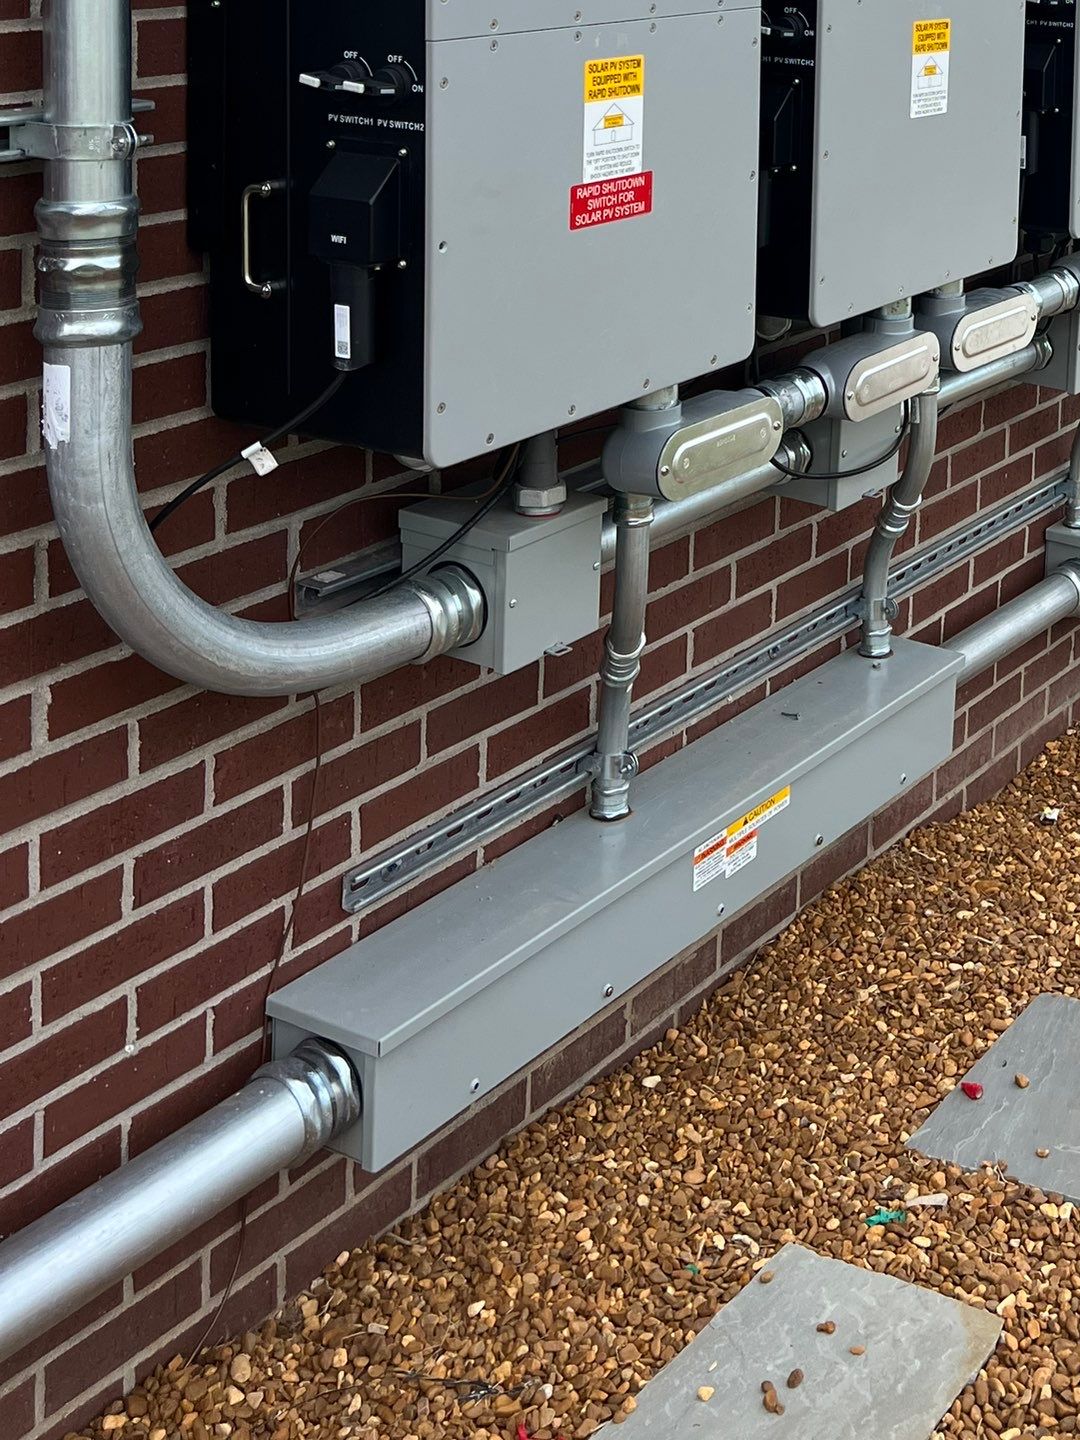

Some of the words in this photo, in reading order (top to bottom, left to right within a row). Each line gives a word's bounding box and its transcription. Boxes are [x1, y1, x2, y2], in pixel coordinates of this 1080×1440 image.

[783, 6, 797, 14] OFF
[804, 29, 815, 37] ON
[343, 50, 359, 59] OFF
[387, 54, 403, 63] OFF
[588, 62, 608, 74] SOLAR
[609, 61, 618, 71] PV
[618, 58, 641, 71] SYSTEM
[592, 73, 621, 87] EQUIPPED
[623, 71, 637, 82] WITH
[411, 84, 424, 93] ON
[588, 88, 607, 100] RAPID
[608, 84, 641, 98] SHUTDOWN
[328, 113, 338, 123] PV
[339, 114, 374, 126] SWITCH1
[377, 118, 388, 128] PV
[389, 120, 425, 131] SWITCH2
[576, 185, 601, 200] RAPID
[601, 176, 646, 195] SHUTDOWN
[587, 194, 617, 211] SWITCH
[618, 190, 635, 204] FOR
[575, 210, 602, 227] SOLAR
[602, 207, 614, 220] PV
[614, 200, 646, 218] SYSTEM
[747, 798, 776, 822] CAUTION
